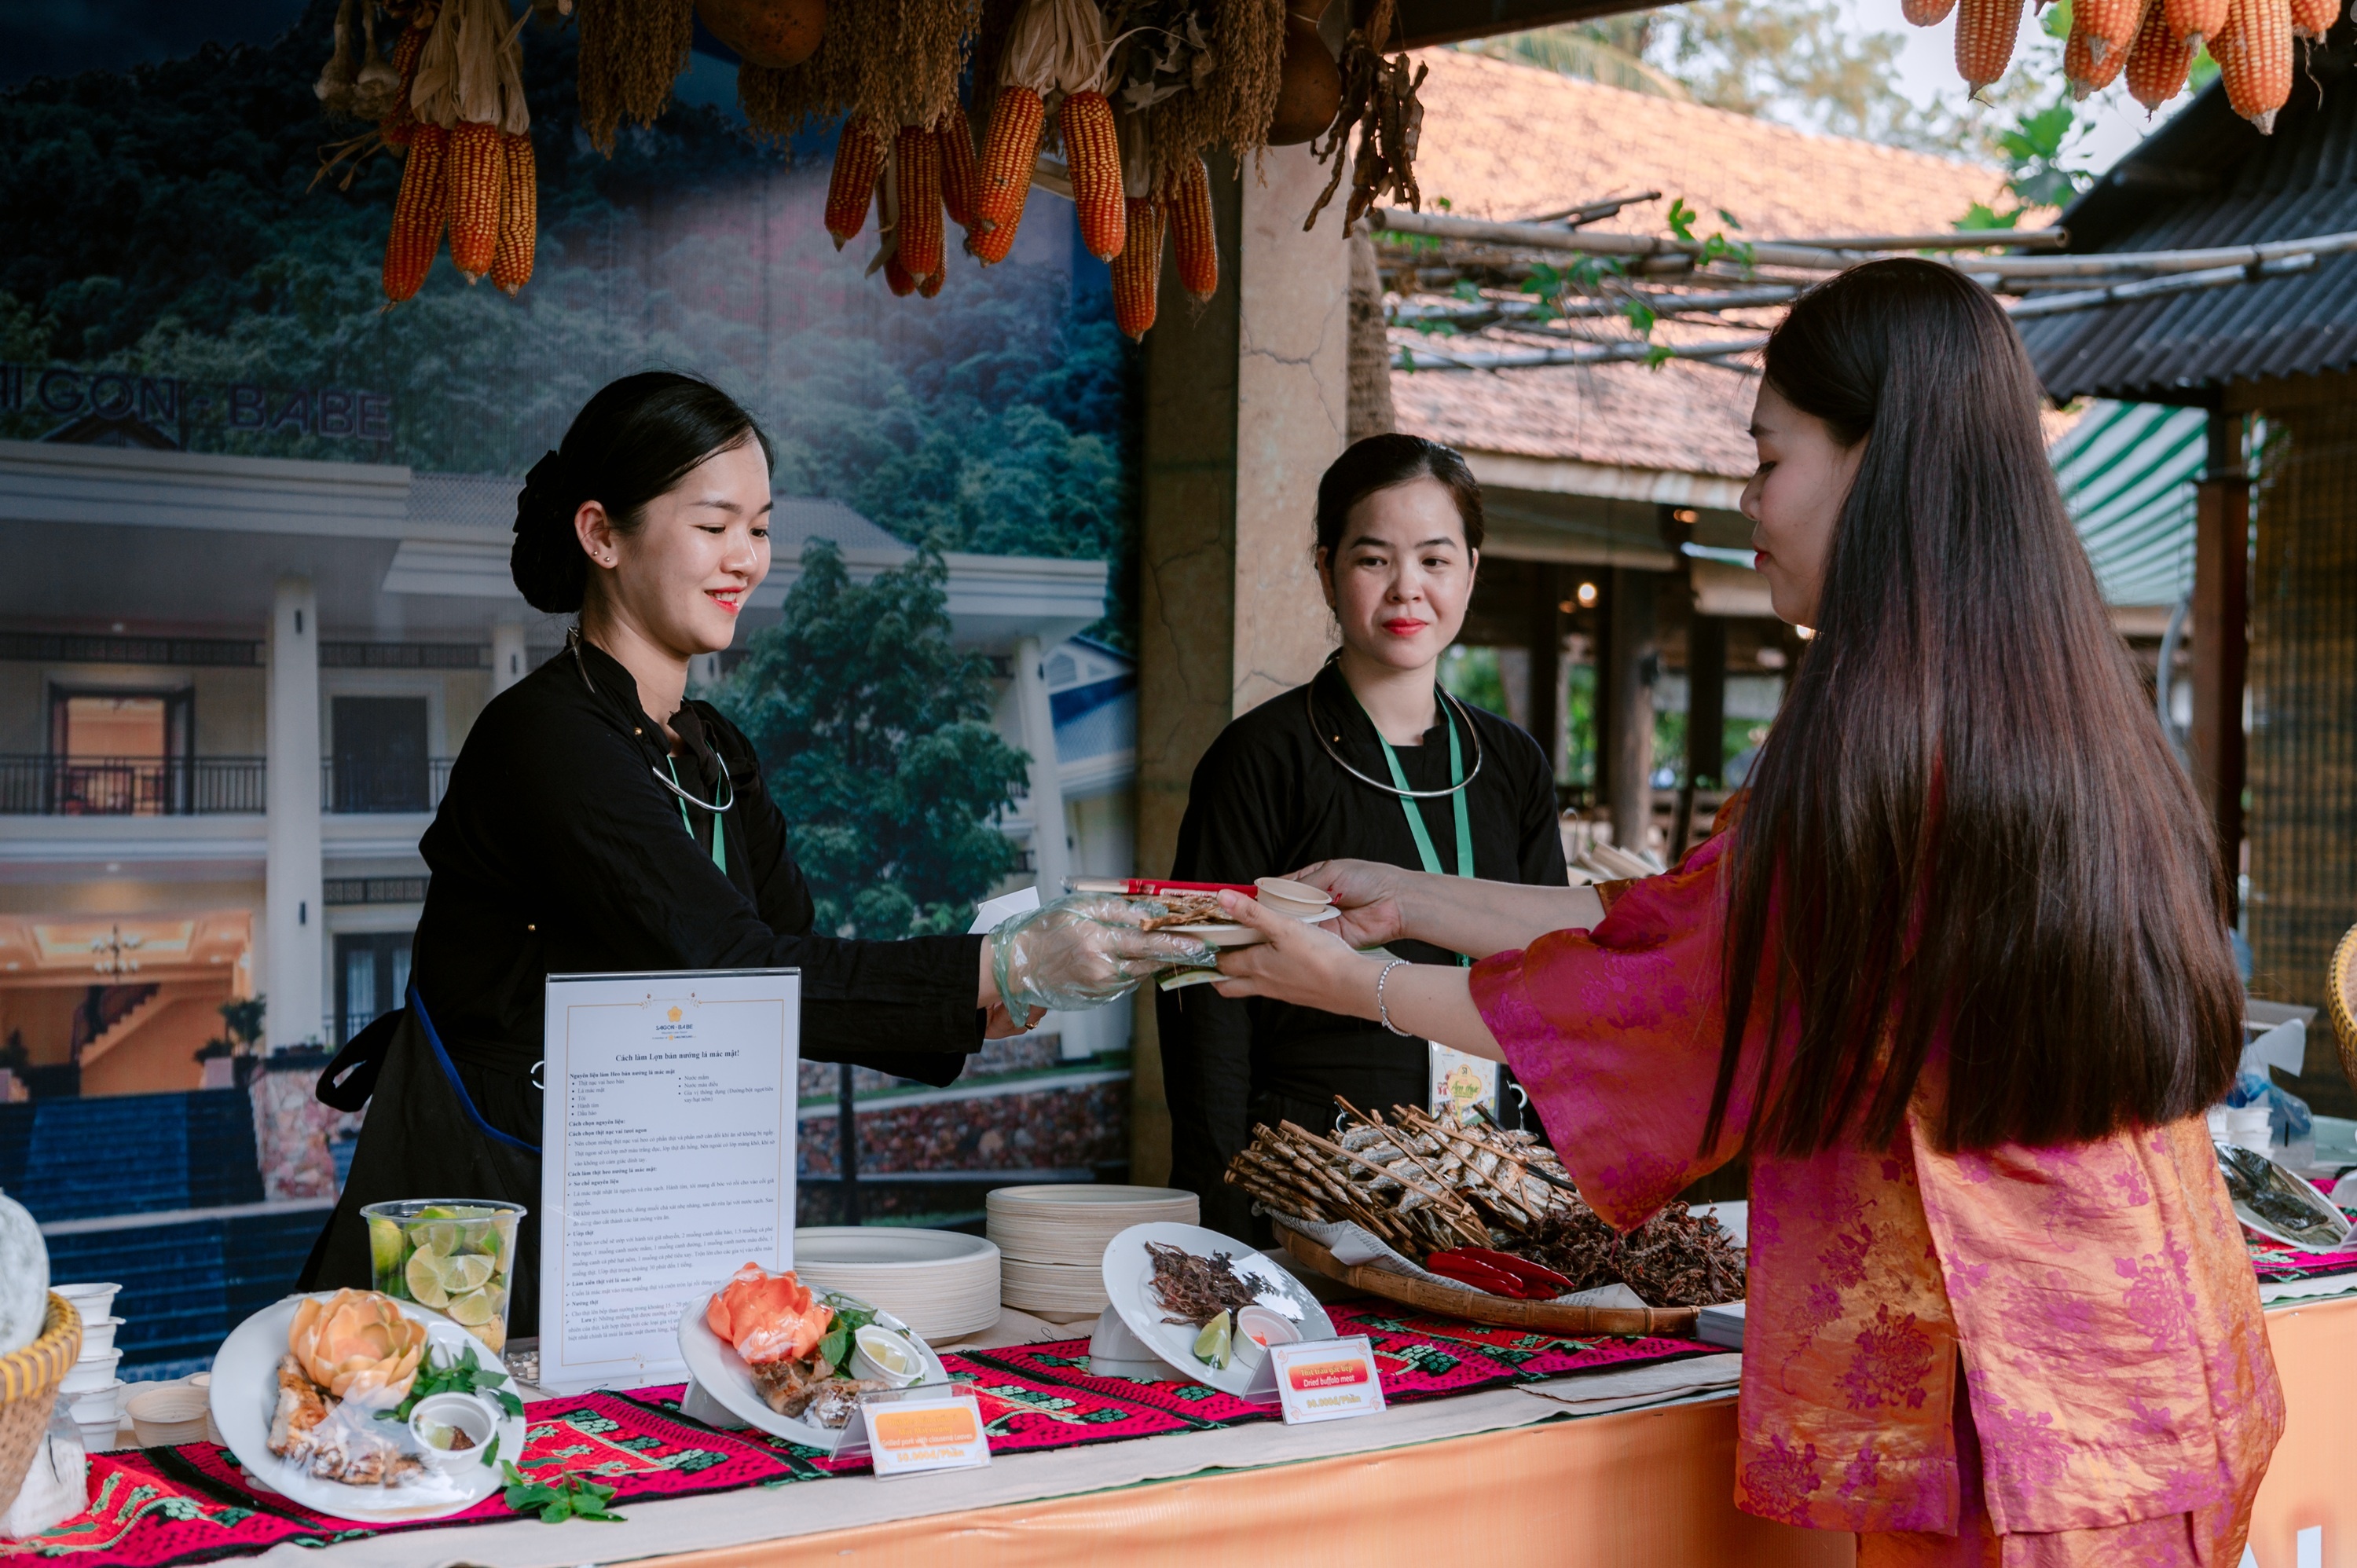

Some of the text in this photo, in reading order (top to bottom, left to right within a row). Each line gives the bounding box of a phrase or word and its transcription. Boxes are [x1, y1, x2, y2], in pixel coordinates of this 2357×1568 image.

[227, 383, 392, 441] BABE
[1303, 1377, 1319, 1387] Dried
[1320, 1376, 1340, 1386] buffalo
[882, 1438, 900, 1447] Grilled
[902, 1437, 915, 1446] pork
